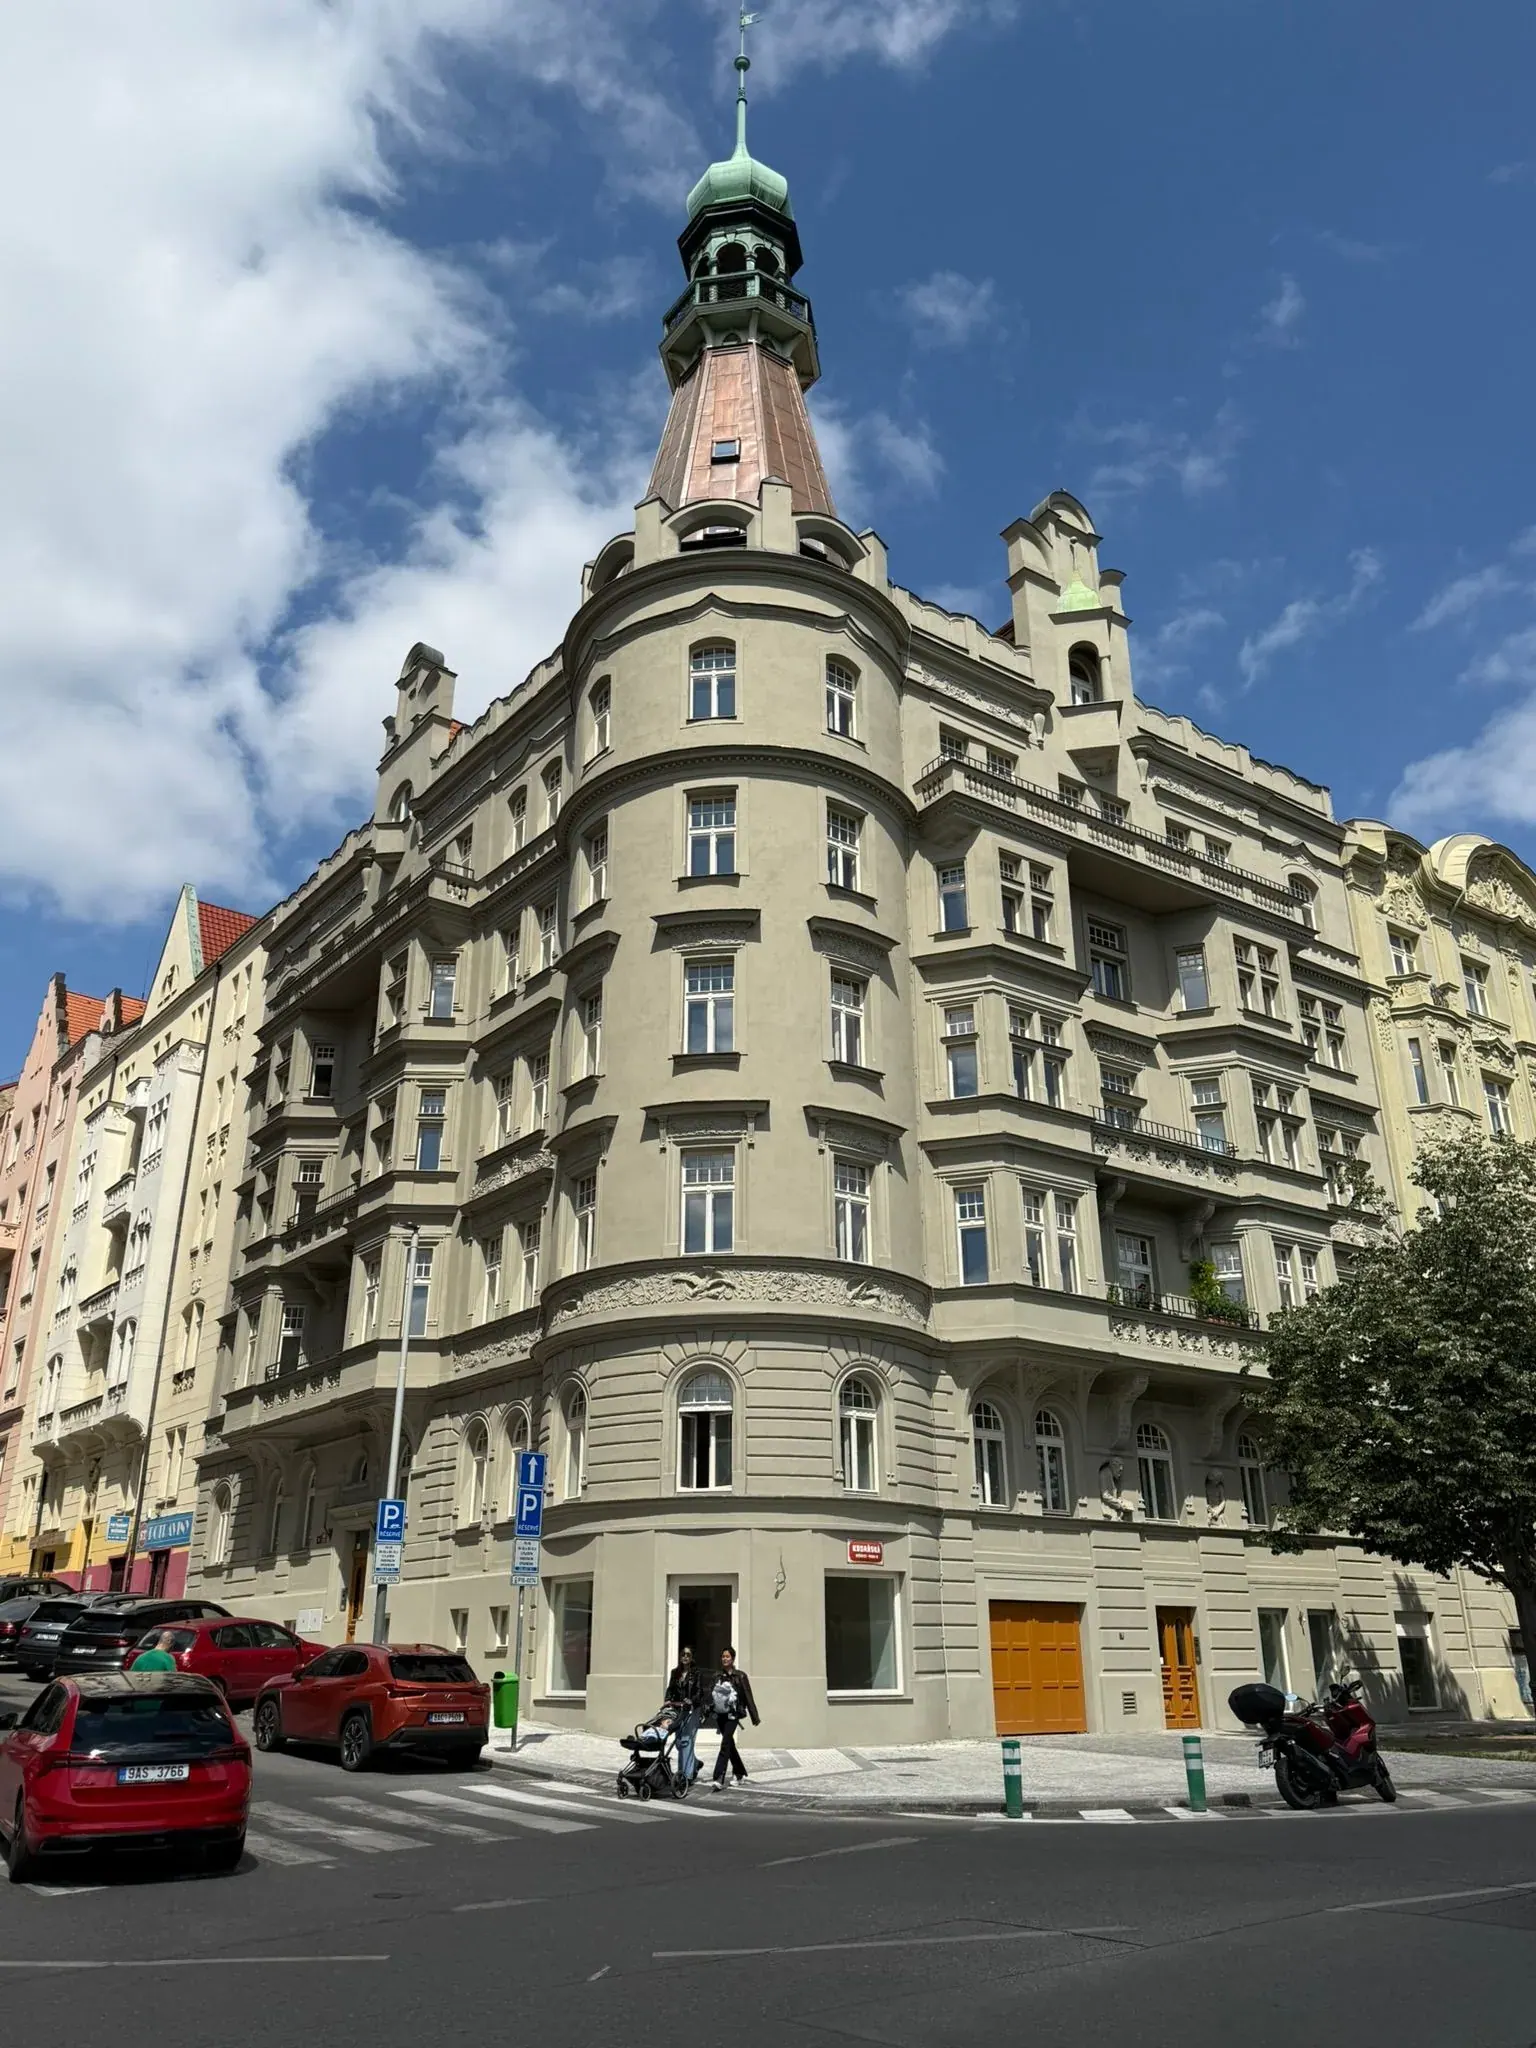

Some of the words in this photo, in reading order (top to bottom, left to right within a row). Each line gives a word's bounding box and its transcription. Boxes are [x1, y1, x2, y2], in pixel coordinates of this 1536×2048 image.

[383, 1505, 400, 1528] P
[522, 1493, 537, 1521] P
[128, 1767, 149, 1779] 9AS
[157, 1765, 184, 1778] 3766
